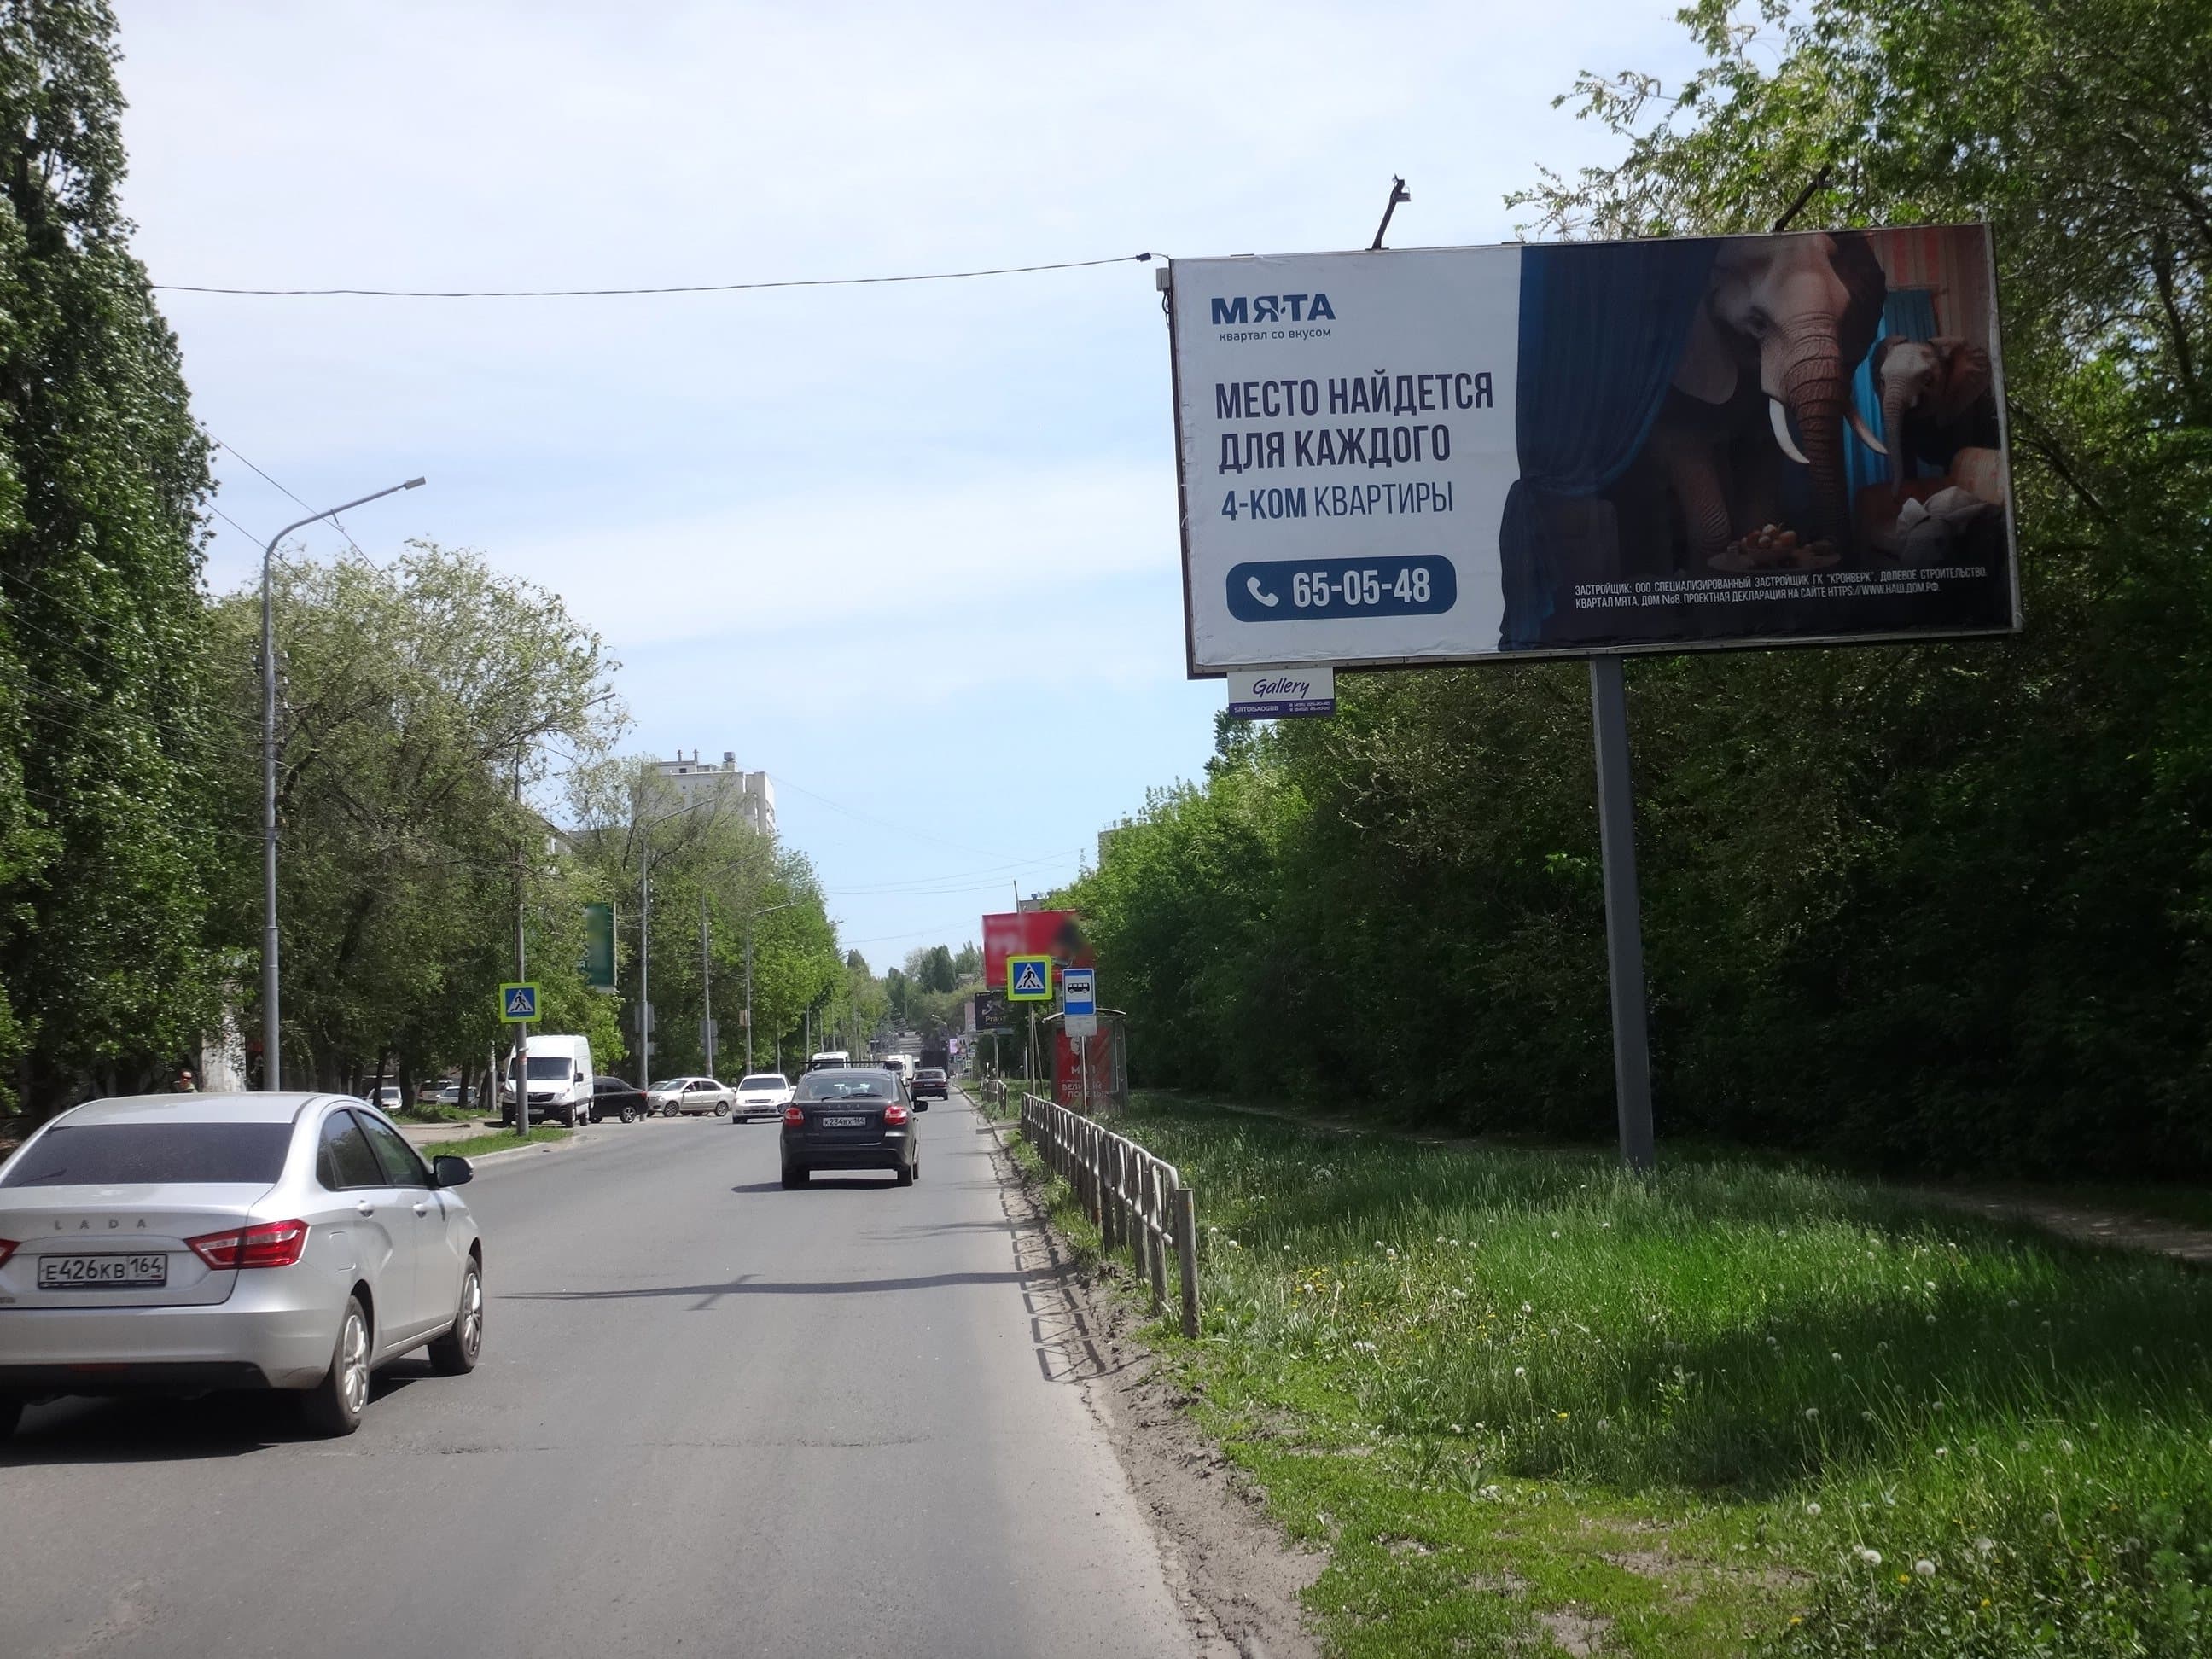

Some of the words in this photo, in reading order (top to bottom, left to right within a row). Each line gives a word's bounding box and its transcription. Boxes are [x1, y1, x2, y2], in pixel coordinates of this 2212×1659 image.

[1211, 294, 1336, 325] МЯТА
[1219, 329, 1267, 343] квартал
[1271, 329, 1284, 340] со
[1289, 328, 1332, 341] вкусом
[1214, 379, 1319, 420] МЕСТО
[1328, 369, 1493, 416] НАЙДЕТСЯ
[1218, 431, 1285, 475] ДЛЯ
[1295, 424, 1451, 469] КАЖДОГО
[1221, 487, 1307, 521] 4-КОМ
[1315, 480, 1453, 517] КВАРТИРЫ
[1293, 568, 1431, 608] 65-05-48
[1575, 583, 1632, 596] ЗАСТРОЙЩИК:
[1635, 582, 1651, 593] ООО
[1655, 576, 1751, 592] СПЕЦИАЛИЗИРОВАННЫЙ
[1755, 574, 1809, 588] ЗАСТРОЙЩИК
[1813, 574, 1823, 585] ГК
[1880, 569, 1917, 582] ДОЛЕВОЕ
[1575, 597, 1614, 608] КВАРТАЛ
[1642, 595, 1660, 607] ДОМ
[1684, 591, 1731, 603] ПРОЕКТНАЯ
[1732, 589, 1786, 602] ДЕКЛАРАЦИЯ
[1789, 588, 1800, 598] НА
[1801, 585, 1826, 597] САЙТЕ
[1253, 678, 1310, 699] Gallery
[55, 1218, 148, 1231] LADA
[46, 1259, 125, 1280] Е426КВ
[130, 1257, 163, 1273] 164
